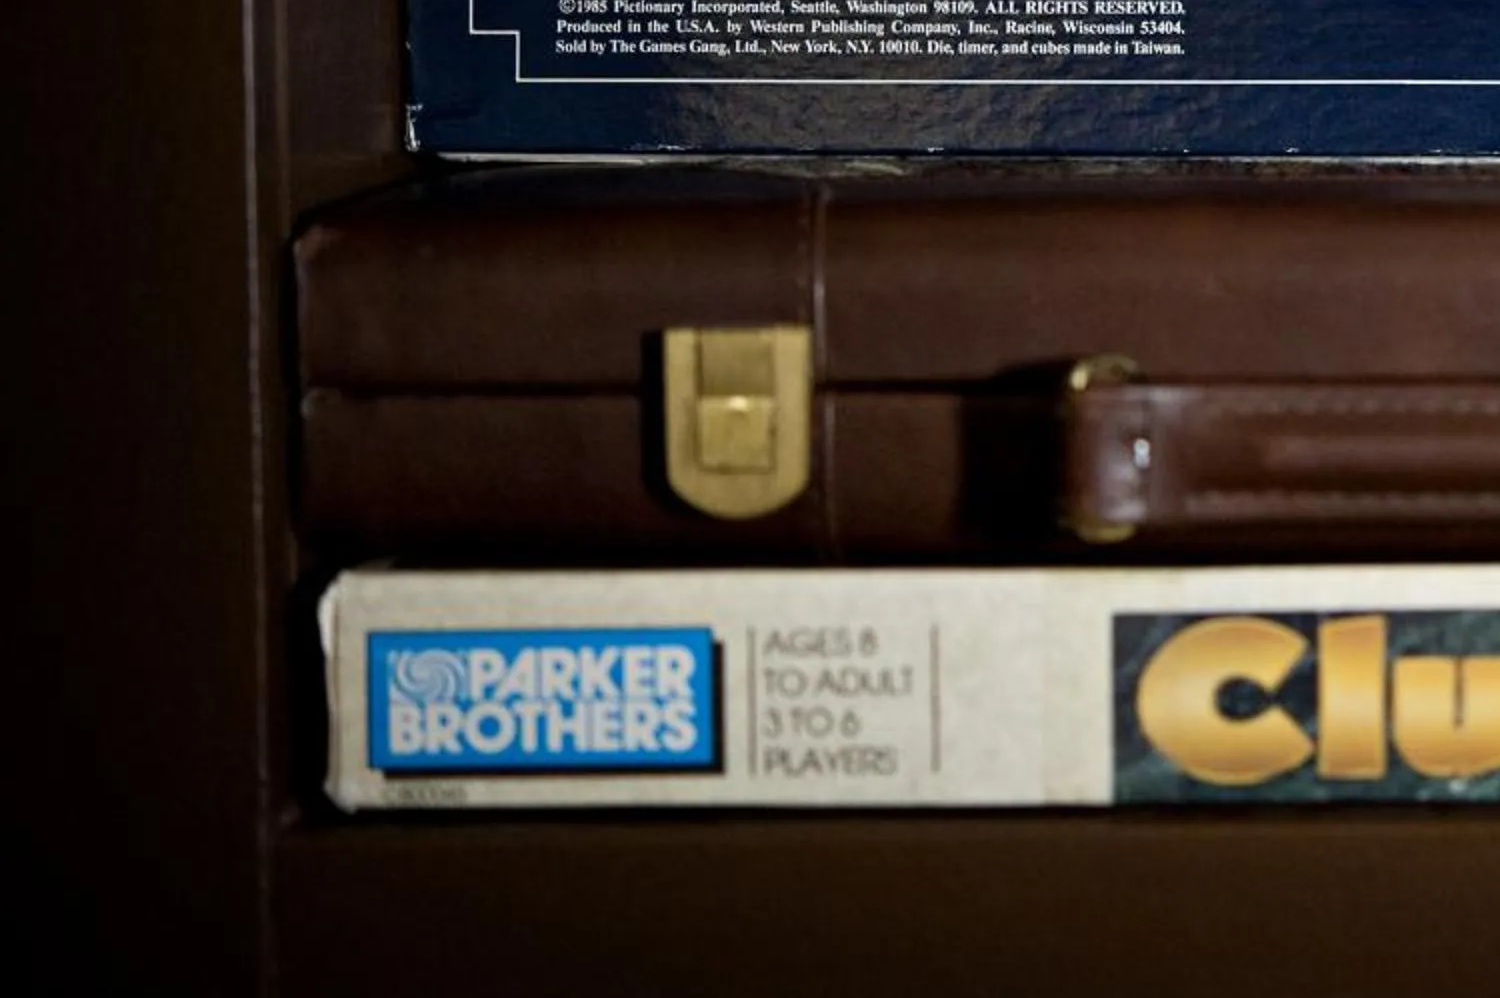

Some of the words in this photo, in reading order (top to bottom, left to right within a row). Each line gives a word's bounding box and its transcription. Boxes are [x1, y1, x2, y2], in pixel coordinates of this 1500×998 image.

[614, 0, 684, 15] Pictionary
[692, 0, 784, 16] Incorporated,
[791, 0, 839, 15] Seattle,
[846, 0, 927, 16] Washington
[933, 0, 978, 14] 98109.
[985, 0, 1019, 15] ALL
[1025, 0, 1088, 14] RIGHTS
[1094, 0, 1185, 15] RESERVED.
[557, 19, 621, 33] Produced
[627, 20, 641, 33] in
[648, 20, 669, 33] the
[676, 20, 720, 33] U.S.A.
[727, 20, 742, 35] by
[750, 20, 805, 33] Western
[811, 20, 885, 36] Publishing
[891, 20, 961, 36] Company,
[1005, 21, 1056, 36] Racine,
[1063, 20, 1134, 35] Wisconsin
[1140, 21, 1185, 35] 53404.
[556, 39, 587, 53] Sold
[590, 39, 606, 55] by
[610, 39, 636, 53] The
[639, 39, 686, 53] Games
[689, 40, 730, 56] Gang,
[771, 40, 800, 53] New
[805, 40, 842, 55] York,
[846, 40, 875, 54] N.Y.
[880, 40, 922, 54] 10010.
[927, 40, 954, 55] Die,
[959, 41, 999, 55] timer,
[1002, 41, 1028, 55] and
[1031, 41, 1071, 55] cubes
[1073, 41, 1111, 55] made
[1114, 41, 1129, 55] in
[1132, 41, 1185, 55] Taiwan.
[763, 628, 852, 658] AGES
[861, 629, 879, 657] 8
[466, 646, 697, 701] PARKER
[763, 668, 808, 696] TO
[813, 667, 914, 695] ADULT
[388, 701, 698, 754] BROTHERS
[763, 710, 781, 738] 3
[787, 708, 834, 737] TO
[841, 709, 862, 737] 6
[763, 746, 898, 776] PLAYERS
